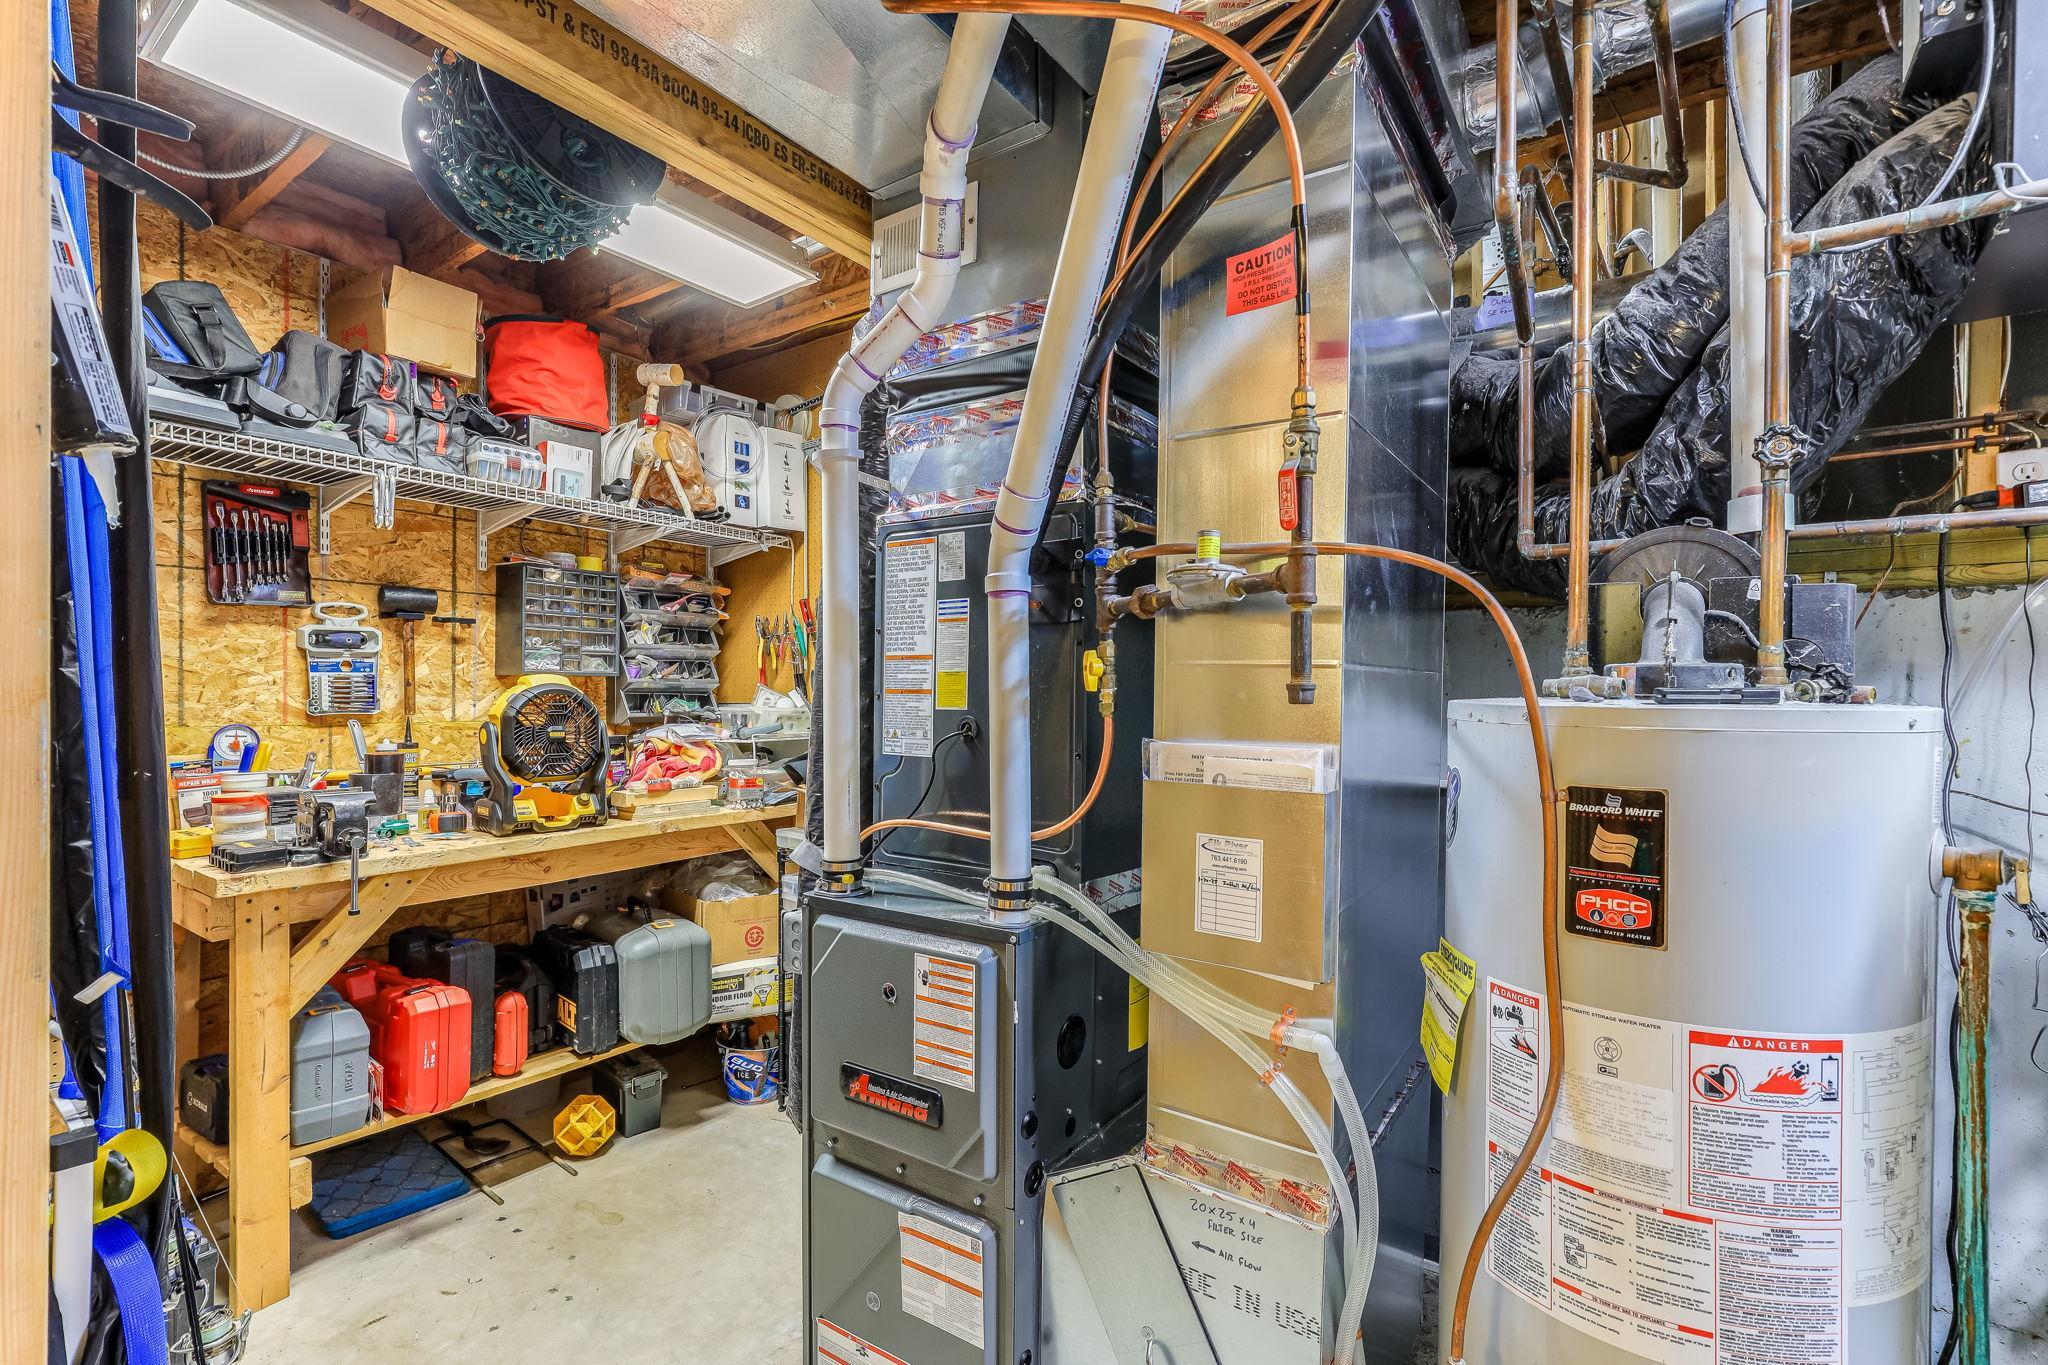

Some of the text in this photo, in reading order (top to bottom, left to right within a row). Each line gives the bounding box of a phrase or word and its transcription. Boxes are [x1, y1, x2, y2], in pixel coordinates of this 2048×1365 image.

[563, 13, 576, 36] &
[580, 21, 605, 54] ESI
[610, 40, 660, 85] 9843A
[662, 73, 699, 110] BOCA
[702, 96, 739, 133] 98-14
[742, 119, 770, 152] ICBO
[774, 142, 788, 163] ES
[1236, 242, 1291, 274] CAUTION
[1247, 265, 1275, 279] PRESSURE
[1262, 269, 1287, 282] PRESSURE
[1250, 286, 1264, 295] NOT
[1266, 277, 1292, 291] DISTURB
[1242, 287, 1290, 307] THIS GAS LINE
[1569, 803, 1662, 818] BRADFORD WHITE
[1575, 812, 1653, 822] CORPORATION
[1211, 855, 1248, 865] 763.441.6190
[1568, 876, 1612, 885] ENERGY
[1570, 868, 1597, 877] Engineered
[1616, 873, 1642, 882] Plumbing
[1581, 894, 1648, 914] PHCC
[1576, 925, 1602, 934] OFFICIAL
[1626, 932, 1651, 941] HEATER
[734, 991, 752, 999] FLOOD
[1501, 990, 1536, 1007] DANGER
[557, 998, 576, 1031] ALT
[1562, 1005, 1590, 1016] AUTOMATIC
[1591, 1013, 1617, 1022] STORAGE
[1639, 1022, 1661, 1030] HEATER
[1743, 1040, 1809, 1050] DANGER
[731, 1057, 763, 1072] BUD
[848, 1073, 929, 1123] Amana
[868, 1083, 885, 1095] Heating
[898, 1093, 929, 1108] Conditioning
[1599, 1191, 1658, 1212] OPERATING INSTRUCTIONS
[1208, 1219, 1264, 1245] FILTER SIZE
[1249, 1219, 1256, 1229] 4
[1218, 1250, 1263, 1272] AIR FLOW
[1233, 1284, 1261, 1318] IN
[1275, 1301, 1321, 1344] USA
